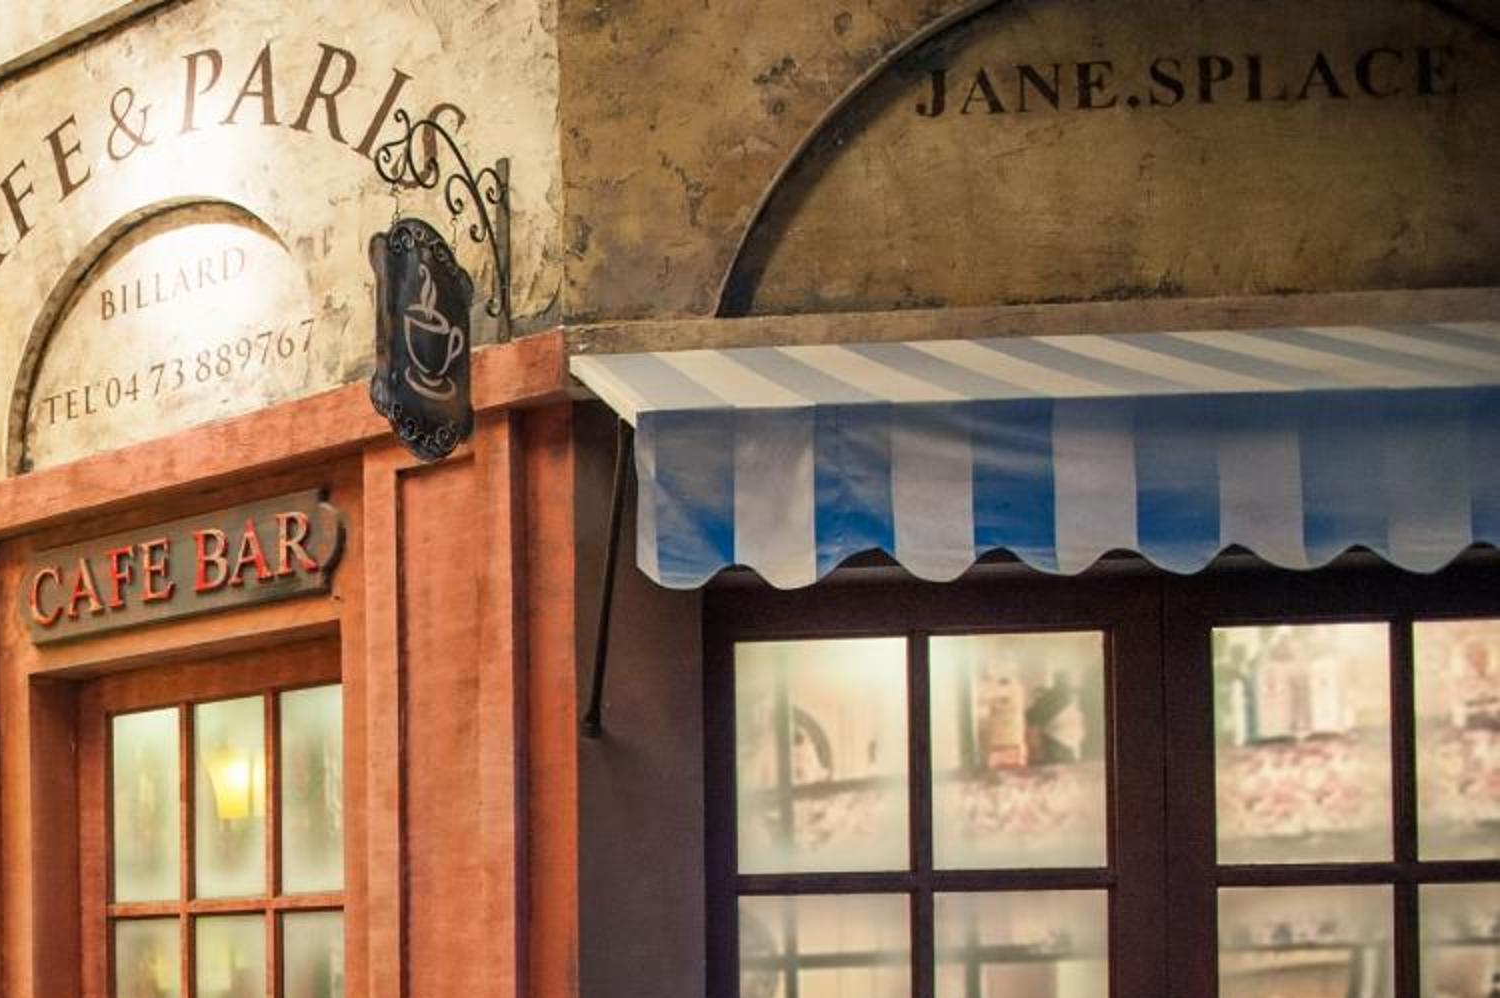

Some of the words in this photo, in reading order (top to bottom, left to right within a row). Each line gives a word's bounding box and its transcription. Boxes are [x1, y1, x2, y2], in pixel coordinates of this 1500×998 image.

[106, 86, 160, 161] &
[180, 41, 467, 188] PARIS
[100, 246, 246, 321] BILLARD
[29, 536, 176, 627] CAFE
[193, 511, 320, 593] BAR
